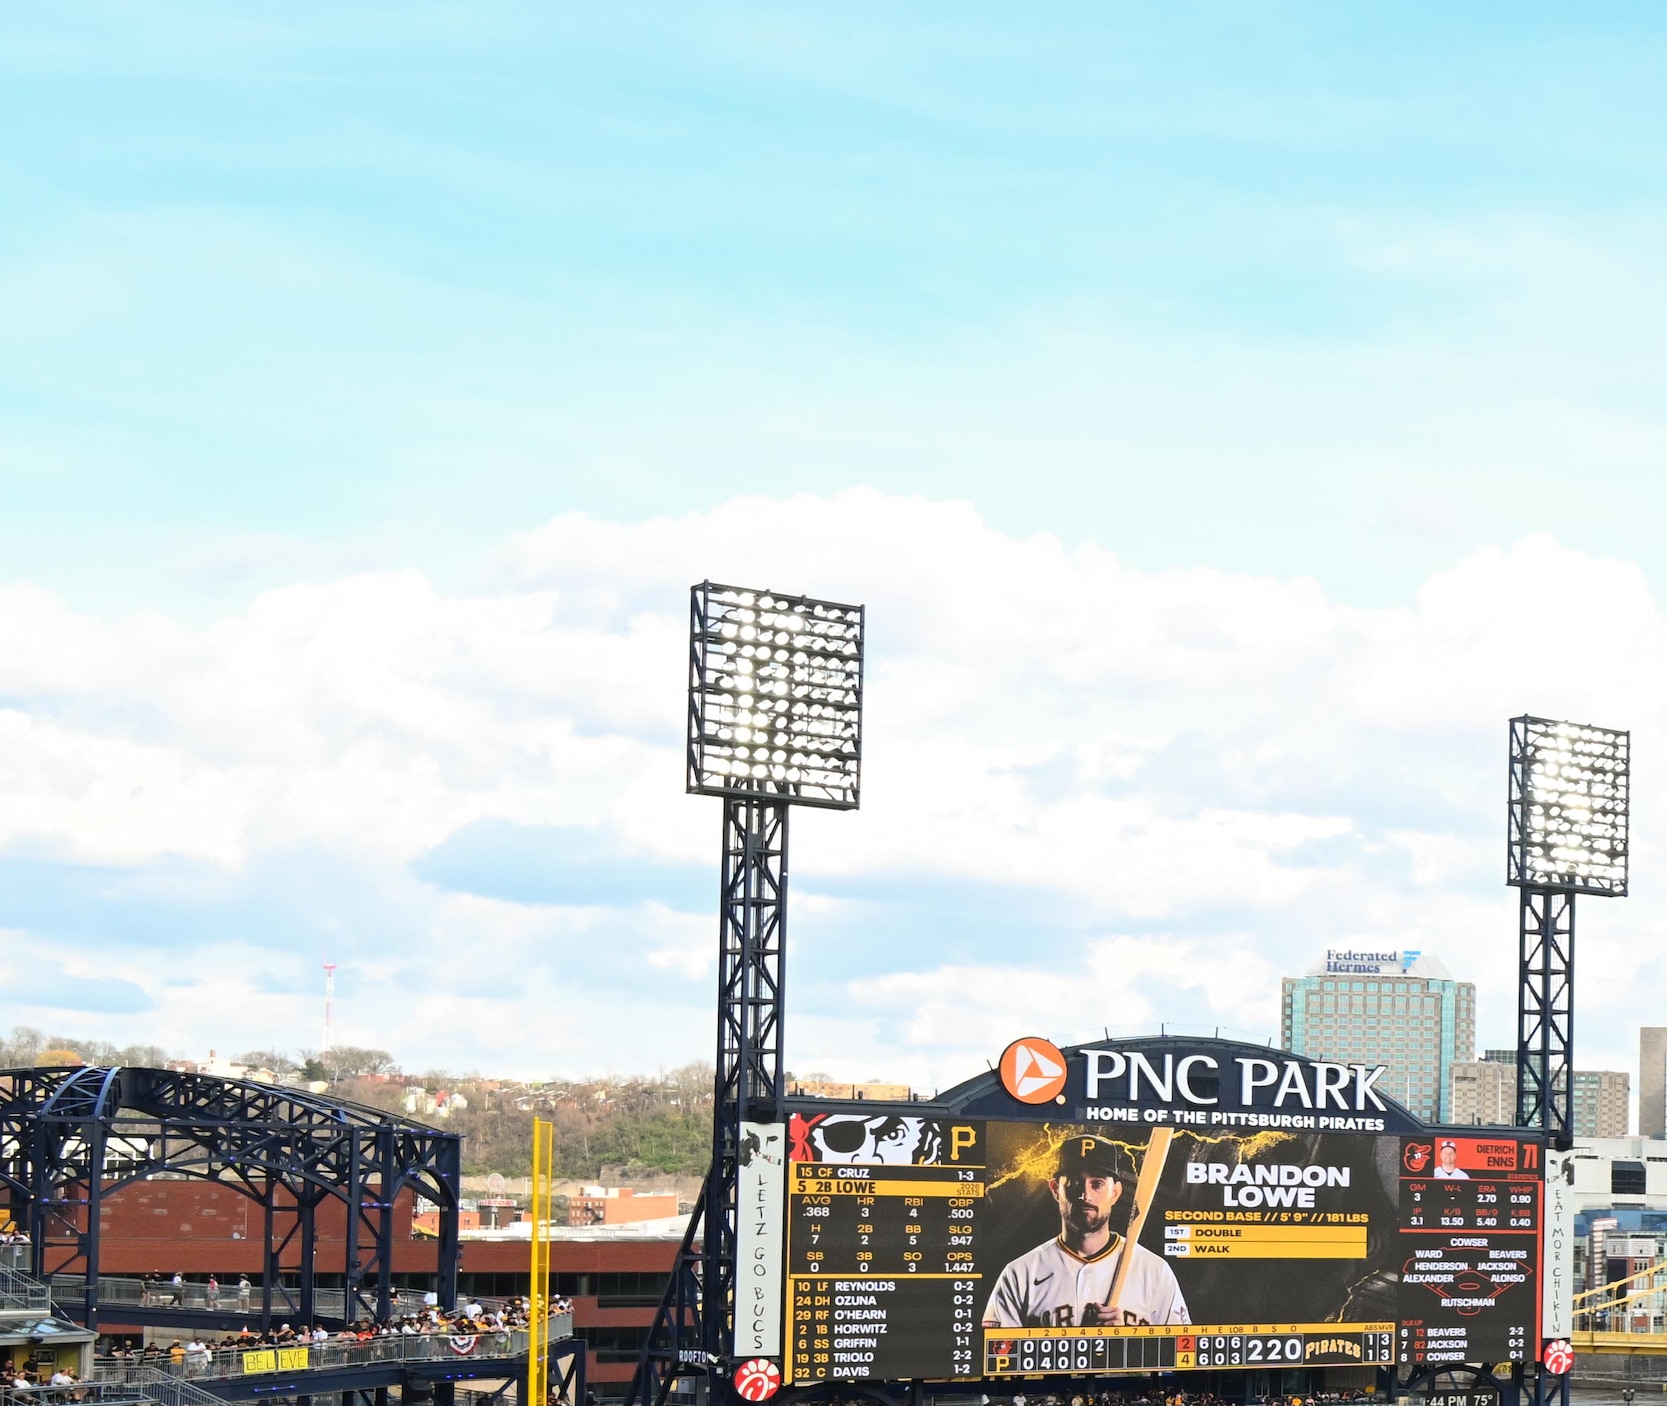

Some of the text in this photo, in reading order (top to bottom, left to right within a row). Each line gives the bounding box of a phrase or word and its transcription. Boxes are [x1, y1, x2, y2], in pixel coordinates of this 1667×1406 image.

[1327, 950, 1397, 961] Federated
[1327, 961, 1380, 973] Hermes
[1079, 1049, 1388, 1112] PNC PARK
[1087, 1106, 1385, 1132] HOME OF THE PITTSBURGH PIRATES
[1477, 1144, 1538, 1168] DIETRICH 71
[1487, 1157, 1514, 1167] ENNS
[800, 1167, 974, 1180] 15 CF CRUZ 1-3
[1186, 1162, 1350, 1187] BRANDON
[798, 1181, 876, 1194] 5 2B LOWE
[1223, 1186, 1315, 1208] LOWE
[1165, 1211, 1224, 1222] SECOND
[1226, 1211, 1261, 1222] BASE
[1326, 1213, 1345, 1223] 181
[1347, 1213, 1368, 1223] LBS
[1169, 1229, 1242, 1238] 1ST DOUBLE
[1450, 1238, 1488, 1247] COWSER
[1167, 1245, 1229, 1254] 2ND WALK
[1415, 1250, 1527, 1259] WARD BEAVERS
[753, 1174, 768, 1349] LETZ GO BUCS
[1415, 1262, 1516, 1270] HENDERSON JACKSON
[1552, 1189, 1564, 1333] EAT MOR CHIKIN
[1403, 1274, 1525, 1283] ALEXANDER ALONSO
[835, 1282, 973, 1291] REYNOLDS 0-2
[835, 1296, 973, 1306] OZUNA 0-2
[1441, 1298, 1495, 1307] RUTSCHMAN
[835, 1309, 972, 1320] O'HEARN 0-1
[834, 1323, 973, 1334] HORWITZ 0-2
[834, 1337, 969, 1348] GRIFFIN 1-1
[834, 1351, 972, 1362] TRIOLO 2-2
[833, 1365, 970, 1377] DAVIS 1-2
